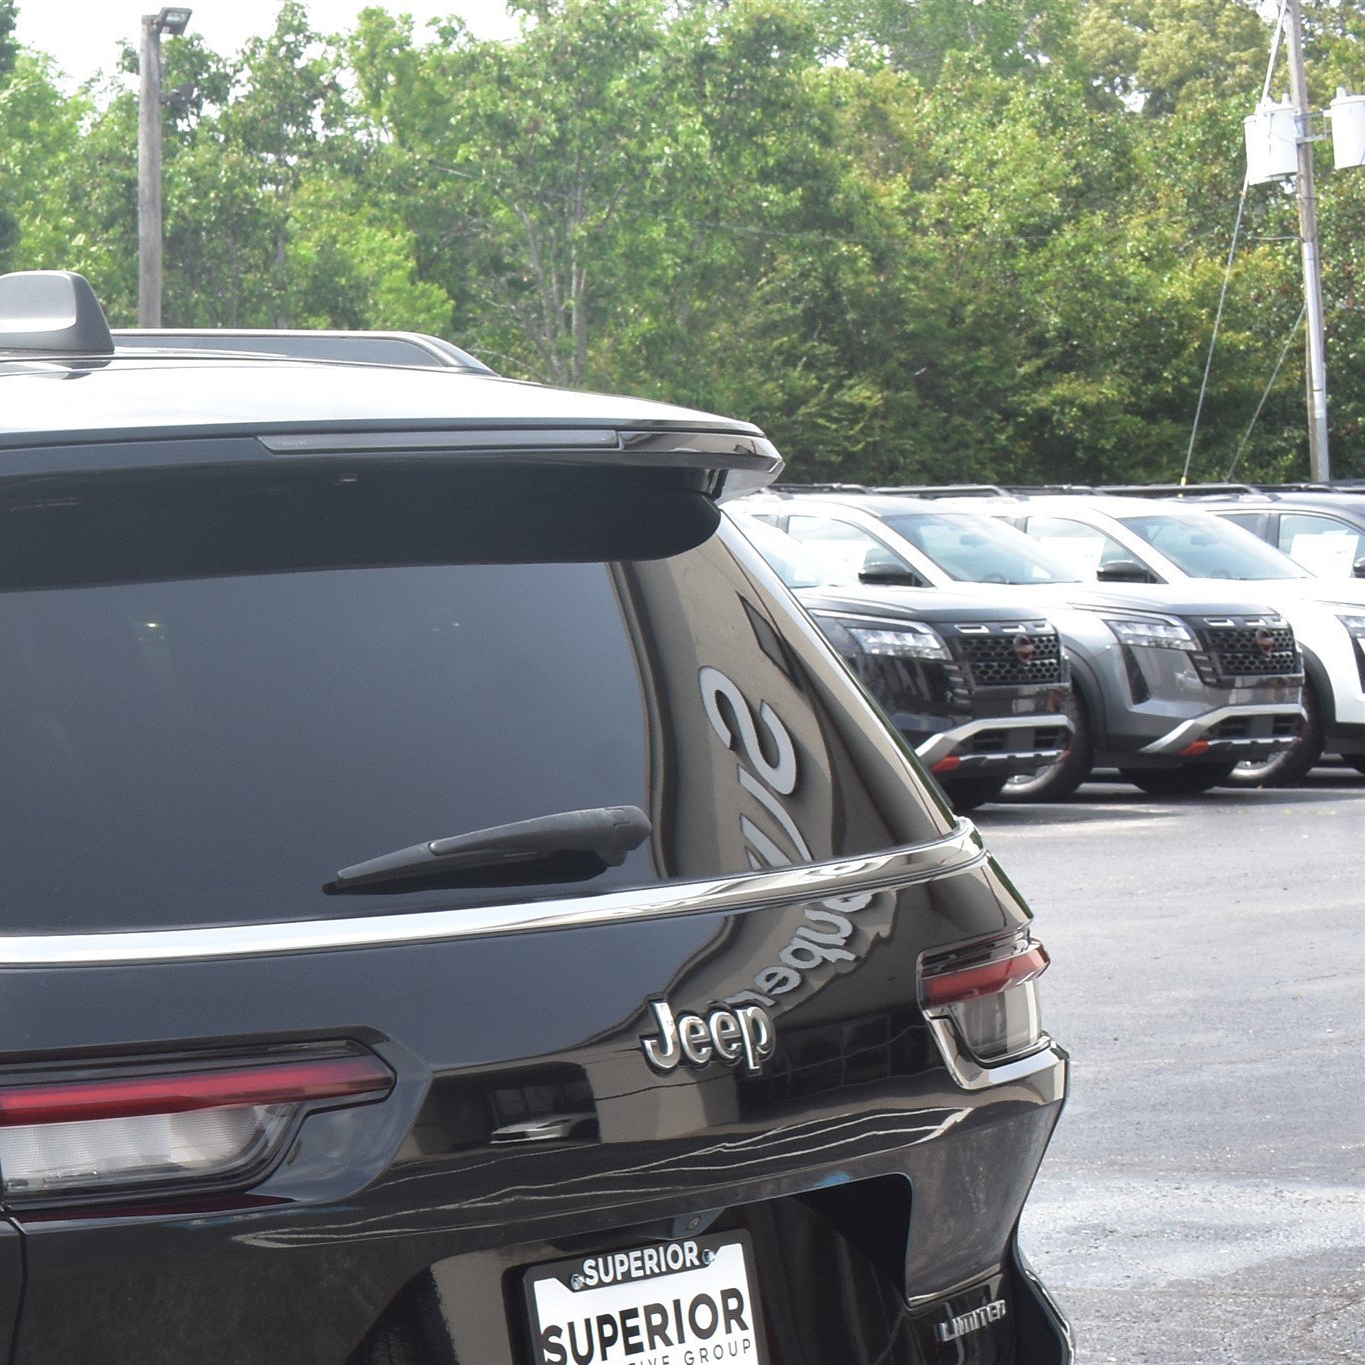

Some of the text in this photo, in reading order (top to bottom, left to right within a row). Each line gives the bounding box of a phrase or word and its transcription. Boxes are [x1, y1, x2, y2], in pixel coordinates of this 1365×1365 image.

[641, 1000, 776, 1073] Jeep
[582, 1240, 700, 1286] SUPERIOR
[939, 1299, 1007, 1342] LIMITED
